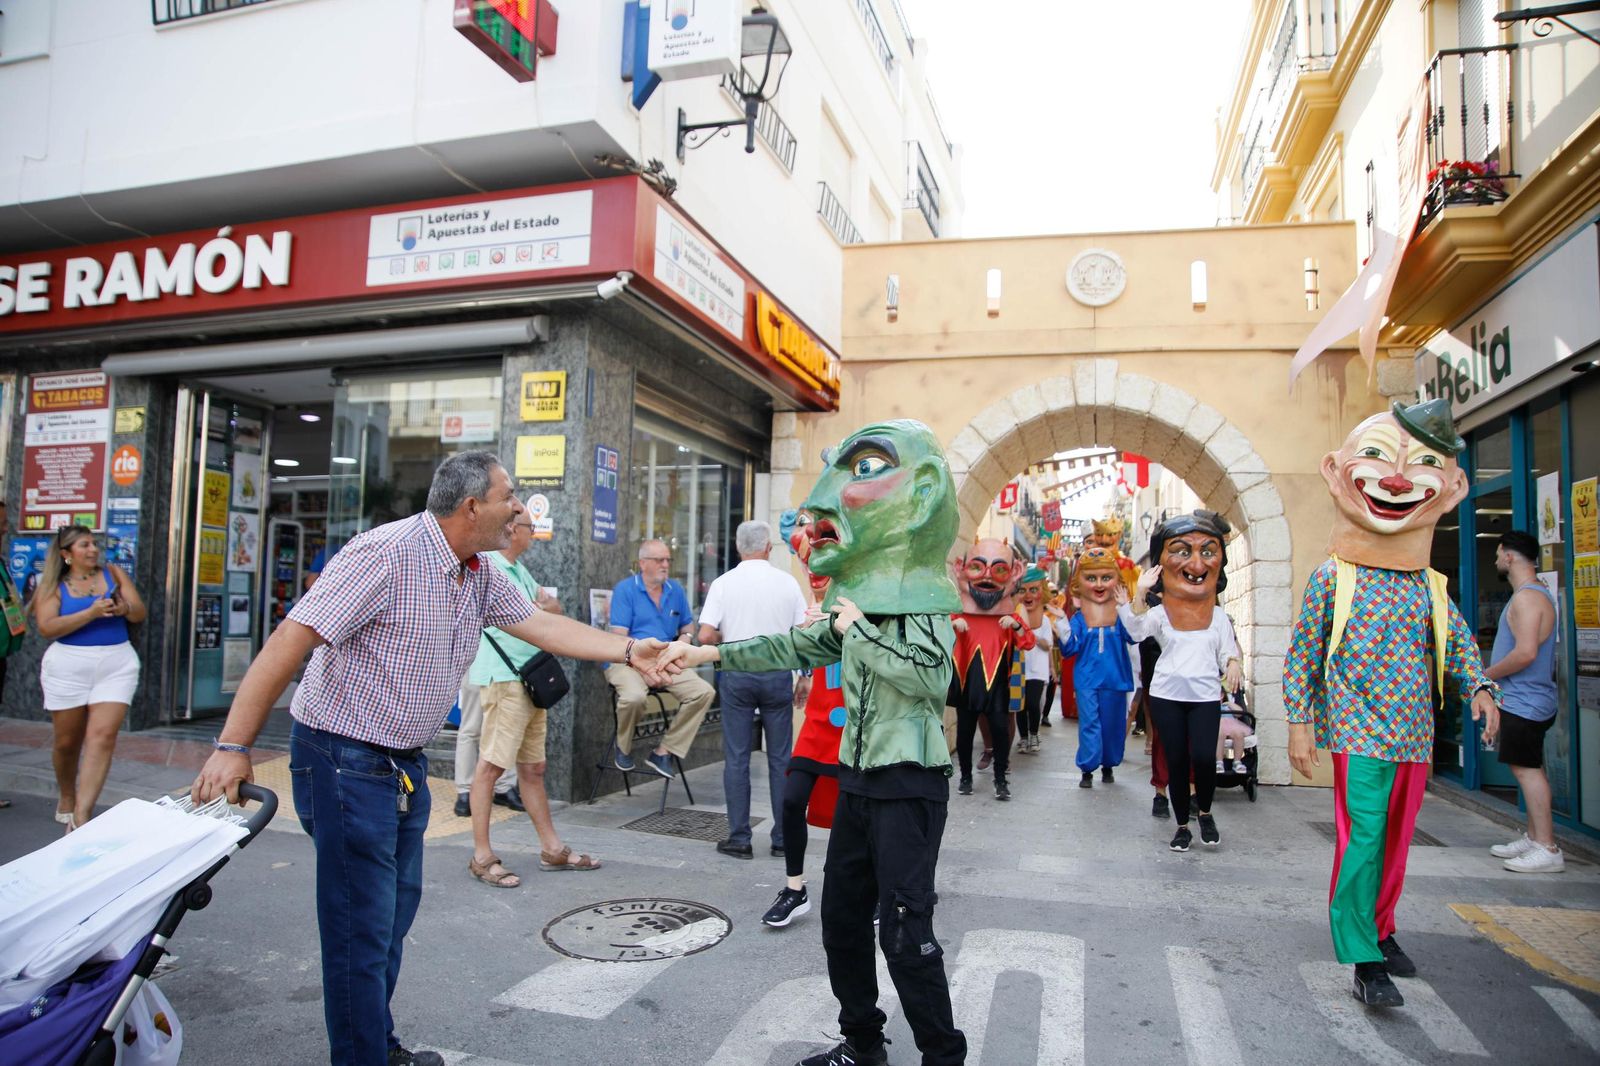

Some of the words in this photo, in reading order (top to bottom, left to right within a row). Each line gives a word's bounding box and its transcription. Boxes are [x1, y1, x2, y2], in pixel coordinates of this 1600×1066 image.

[427, 208, 479, 225] Loterías
[483, 207, 491, 220] y
[427, 224, 486, 240] Apuestas
[490, 218, 510, 232] del
[513, 214, 560, 231] Estado
[63, 225, 293, 309] RAMÓN
[1437, 320, 1512, 407] Belia
[47, 387, 104, 403] TABACOS
[531, 382, 558, 398] WU
[114, 450, 138, 473] ria
[25, 516, 45, 530] WU
